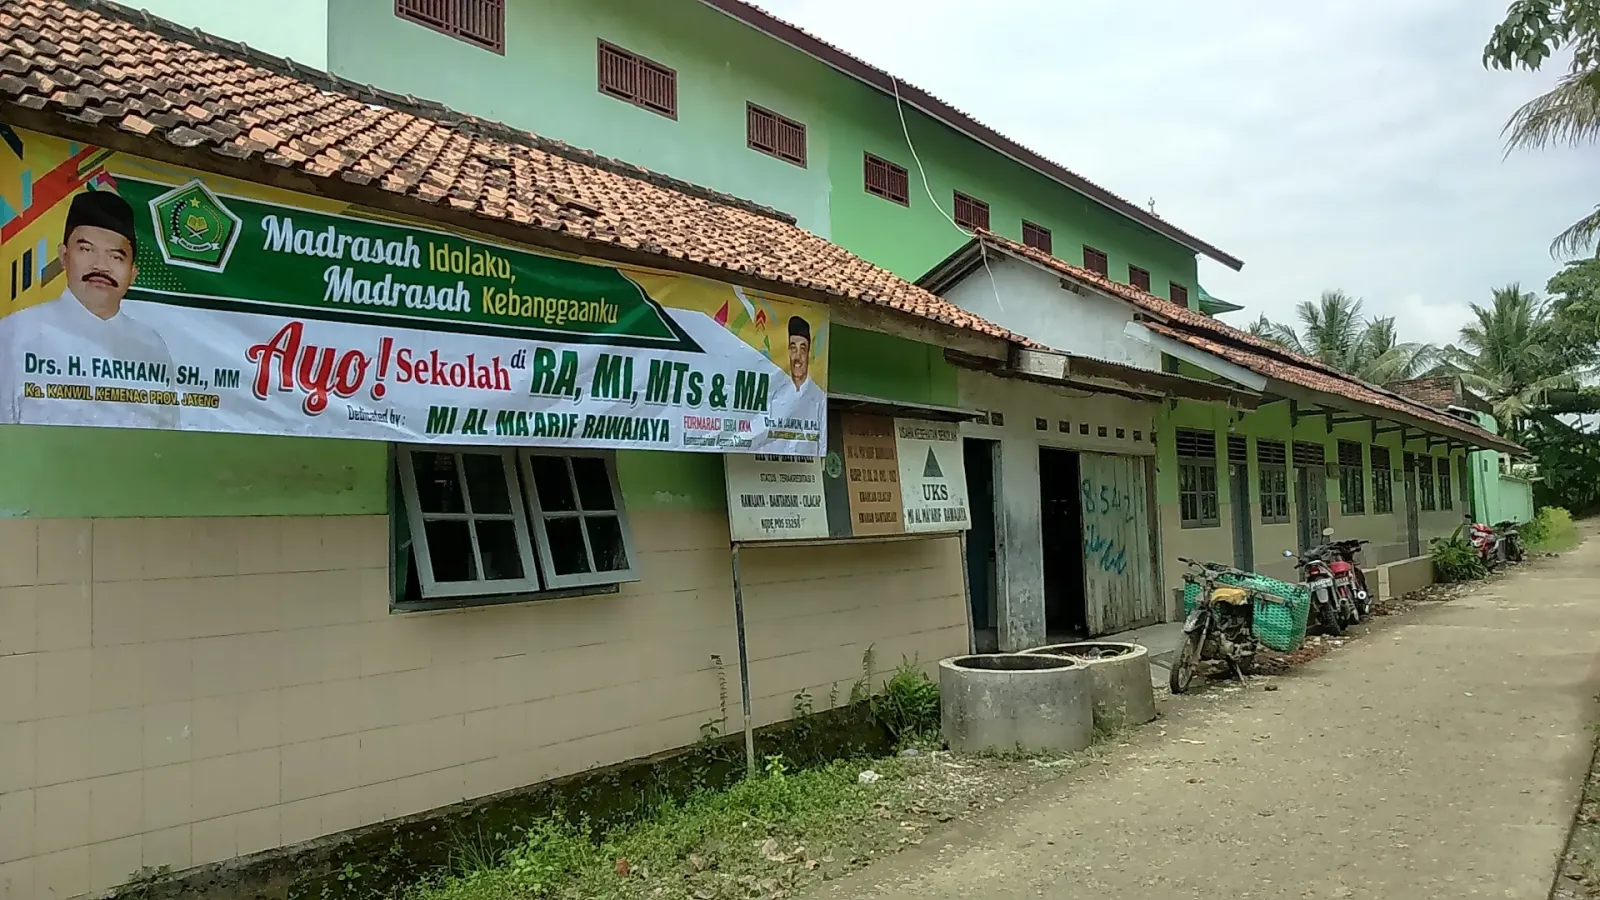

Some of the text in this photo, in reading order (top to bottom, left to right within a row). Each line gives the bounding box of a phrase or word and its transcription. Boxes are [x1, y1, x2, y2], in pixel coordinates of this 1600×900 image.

[261, 215, 517, 284] Madrasah Idolaku,
[323, 266, 620, 325] Madrasah Kebanggaanku
[25, 352, 240, 390] Drs. H. FARHANI, SH., MM
[396, 348, 511, 391] Sekolah
[511, 349, 527, 370] di
[530, 347, 582, 405] RA,
[591, 353, 638, 408] MI,
[645, 358, 703, 408] MTs
[708, 374, 728, 410] &
[733, 370, 770, 413] MA
[24, 382, 219, 408] Ka. KANWIL KEMENAG PROV. JATENG
[425, 406, 458, 434] MI
[462, 408, 488, 435] AL
[496, 409, 579, 438] MA'ARIF
[582, 414, 669, 442] RAWAJAYA
[740, 494, 766, 508] RAWAJAYA
[922, 483, 949, 501] UKS
[774, 518, 784, 529] POS
